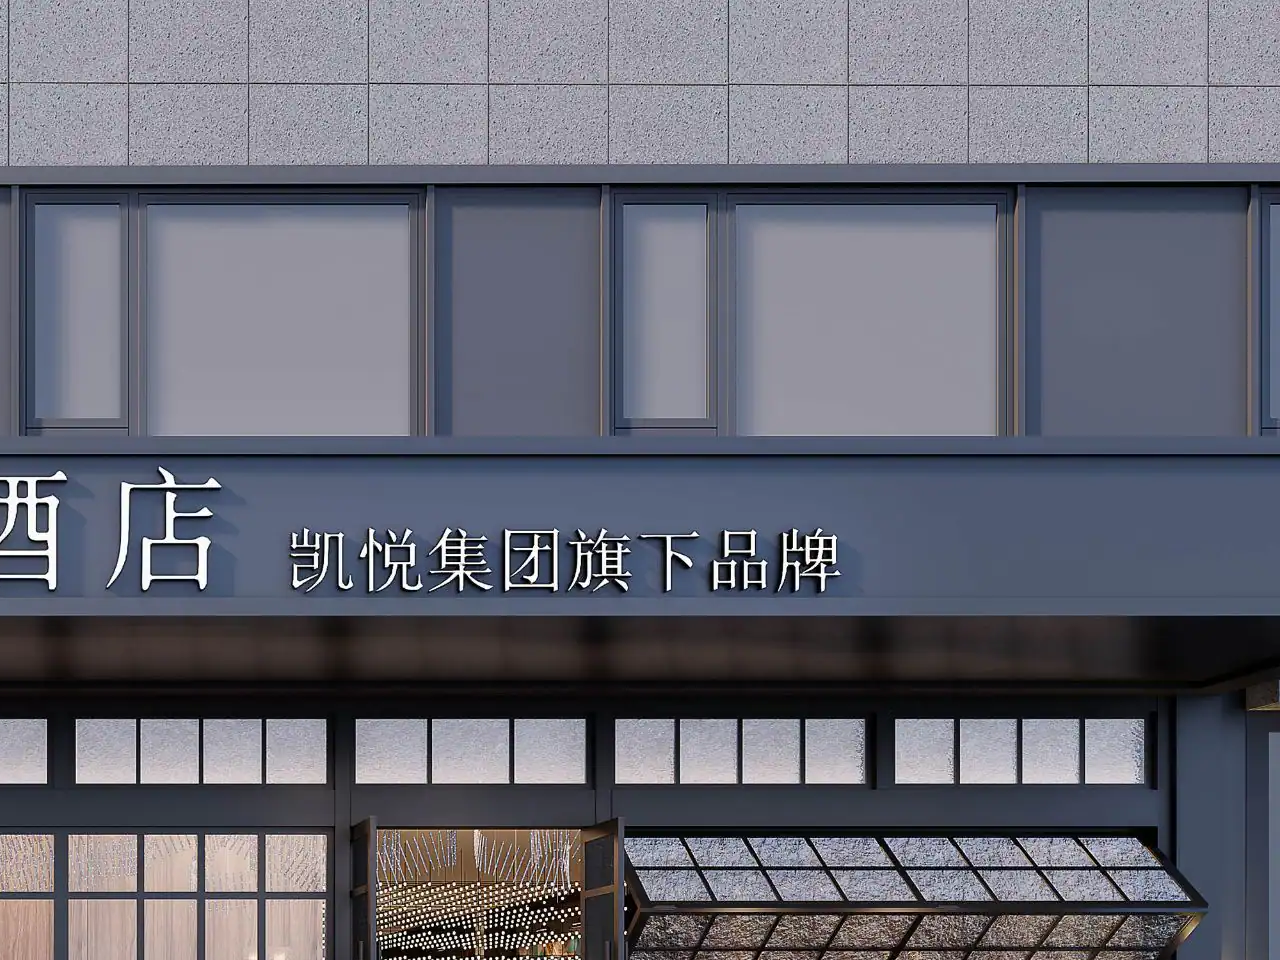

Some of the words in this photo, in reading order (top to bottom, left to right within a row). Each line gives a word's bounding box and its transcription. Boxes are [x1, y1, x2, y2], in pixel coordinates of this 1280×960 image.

[289, 526, 841, 592] 凯悦集团旗下品牌
